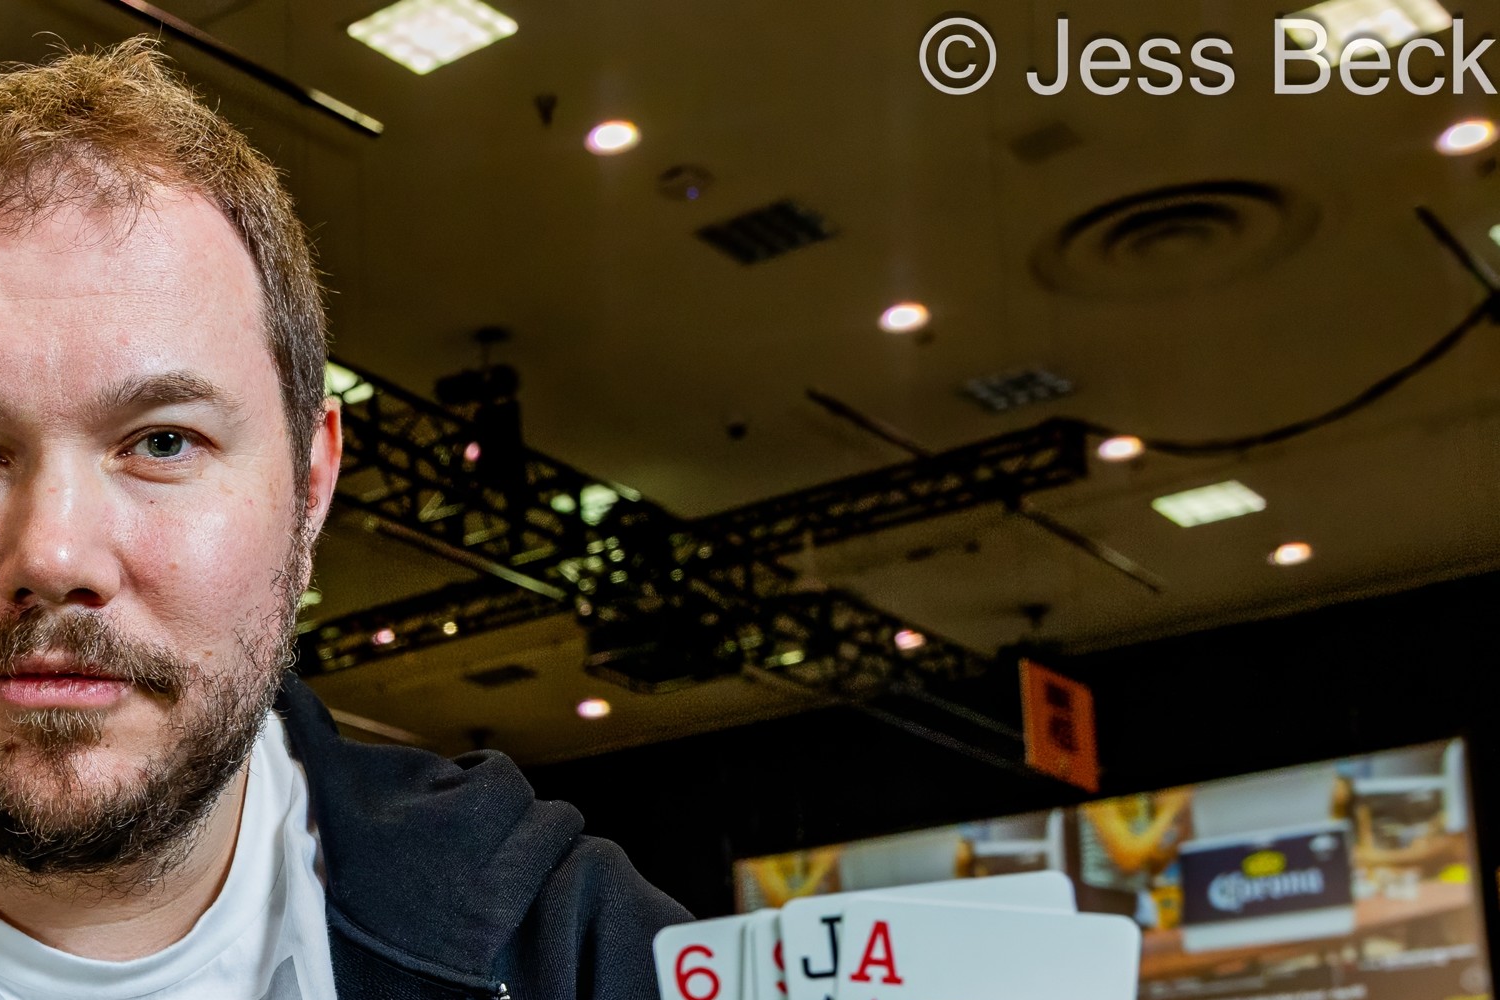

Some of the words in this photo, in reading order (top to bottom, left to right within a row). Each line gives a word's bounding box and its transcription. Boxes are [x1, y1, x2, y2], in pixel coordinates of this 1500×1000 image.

[1208, 867, 1324, 912] Corona
[801, 915, 842, 979] J
[849, 920, 904, 986] A
